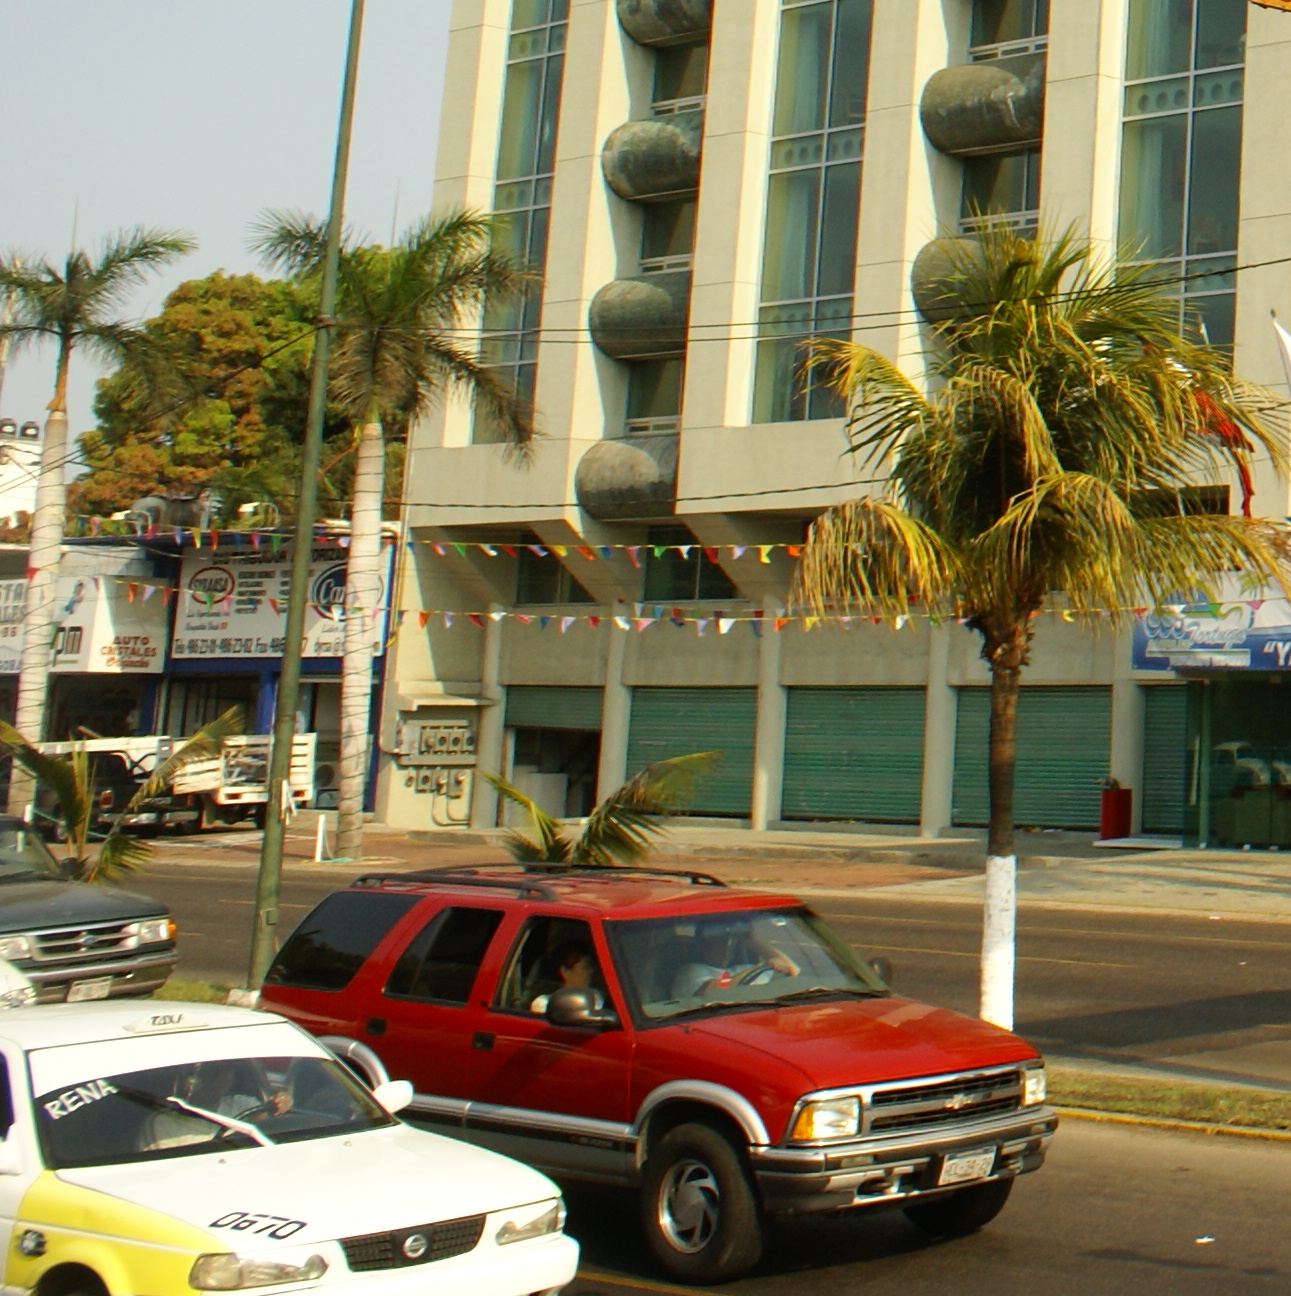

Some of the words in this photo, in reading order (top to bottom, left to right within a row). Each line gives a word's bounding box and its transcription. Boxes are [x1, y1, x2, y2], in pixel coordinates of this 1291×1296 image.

[114, 635, 150, 646] AUTO
[44, 1079, 119, 1120] RENA
[208, 1211, 307, 1241] 0670
